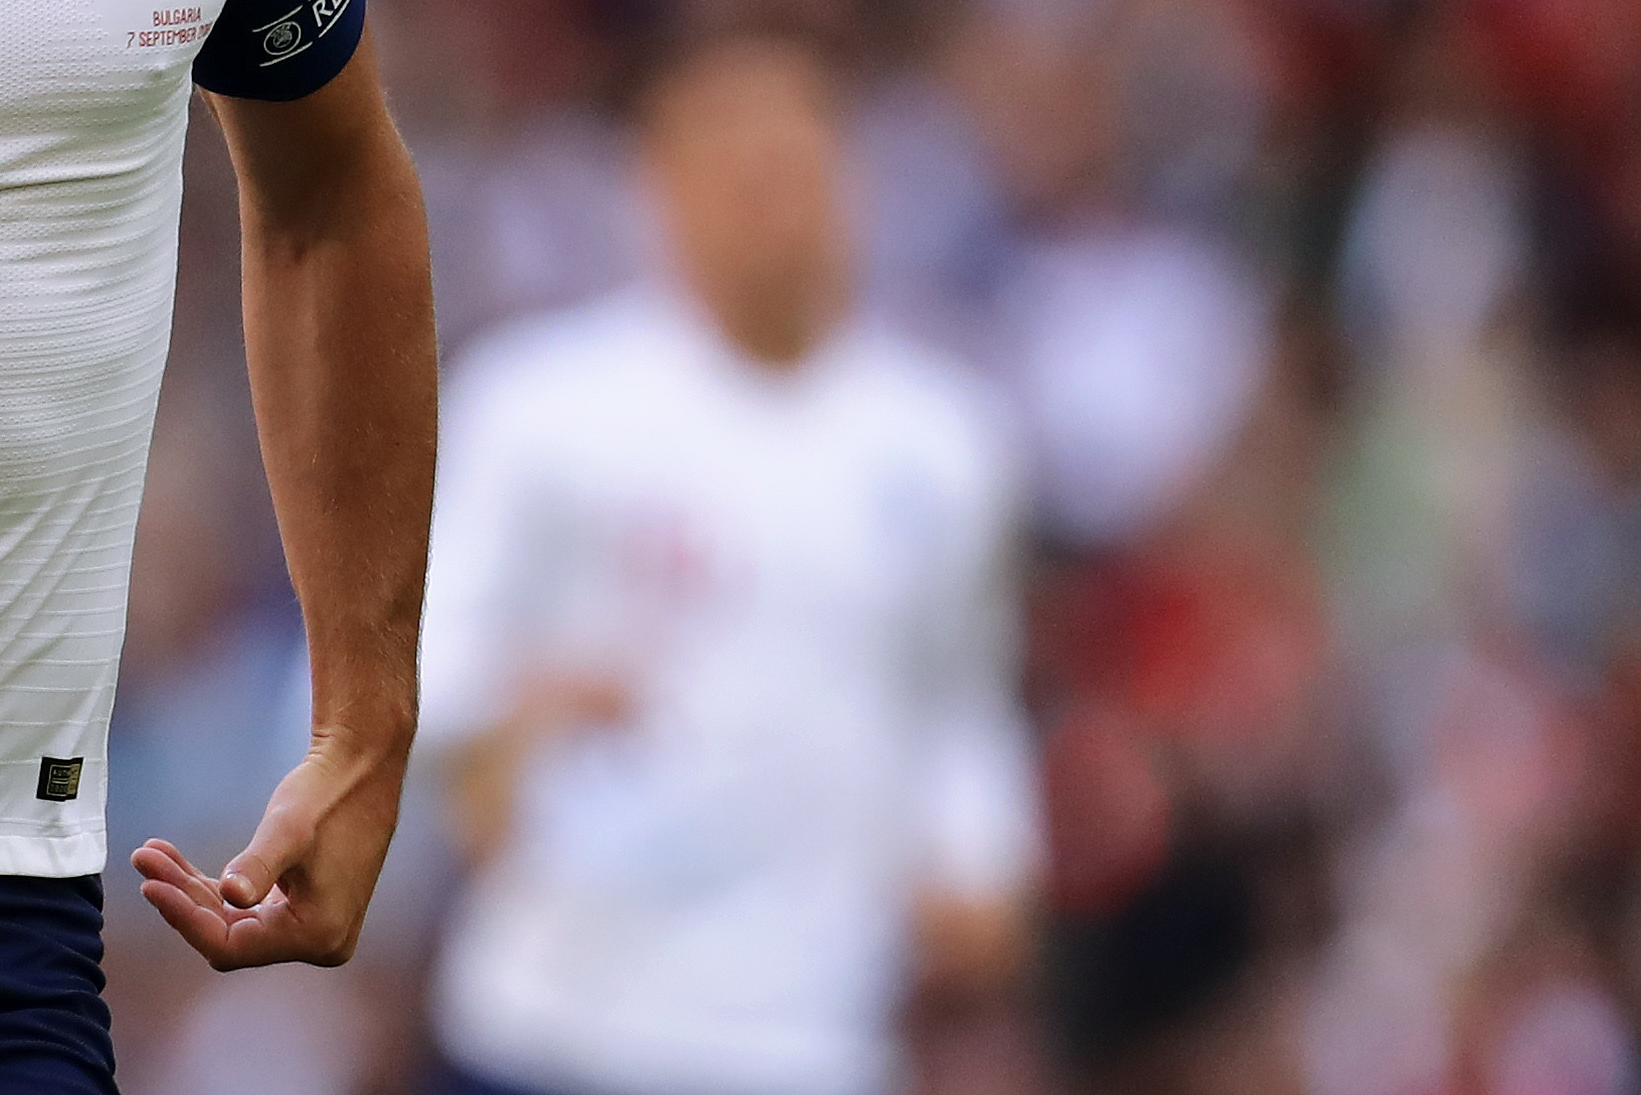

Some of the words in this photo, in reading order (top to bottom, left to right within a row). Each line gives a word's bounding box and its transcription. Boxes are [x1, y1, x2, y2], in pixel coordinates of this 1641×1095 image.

[153, 7, 202, 27] BULGARIA
[126, 31, 135, 49] 7
[139, 27, 197, 47] SEPTEMBER
